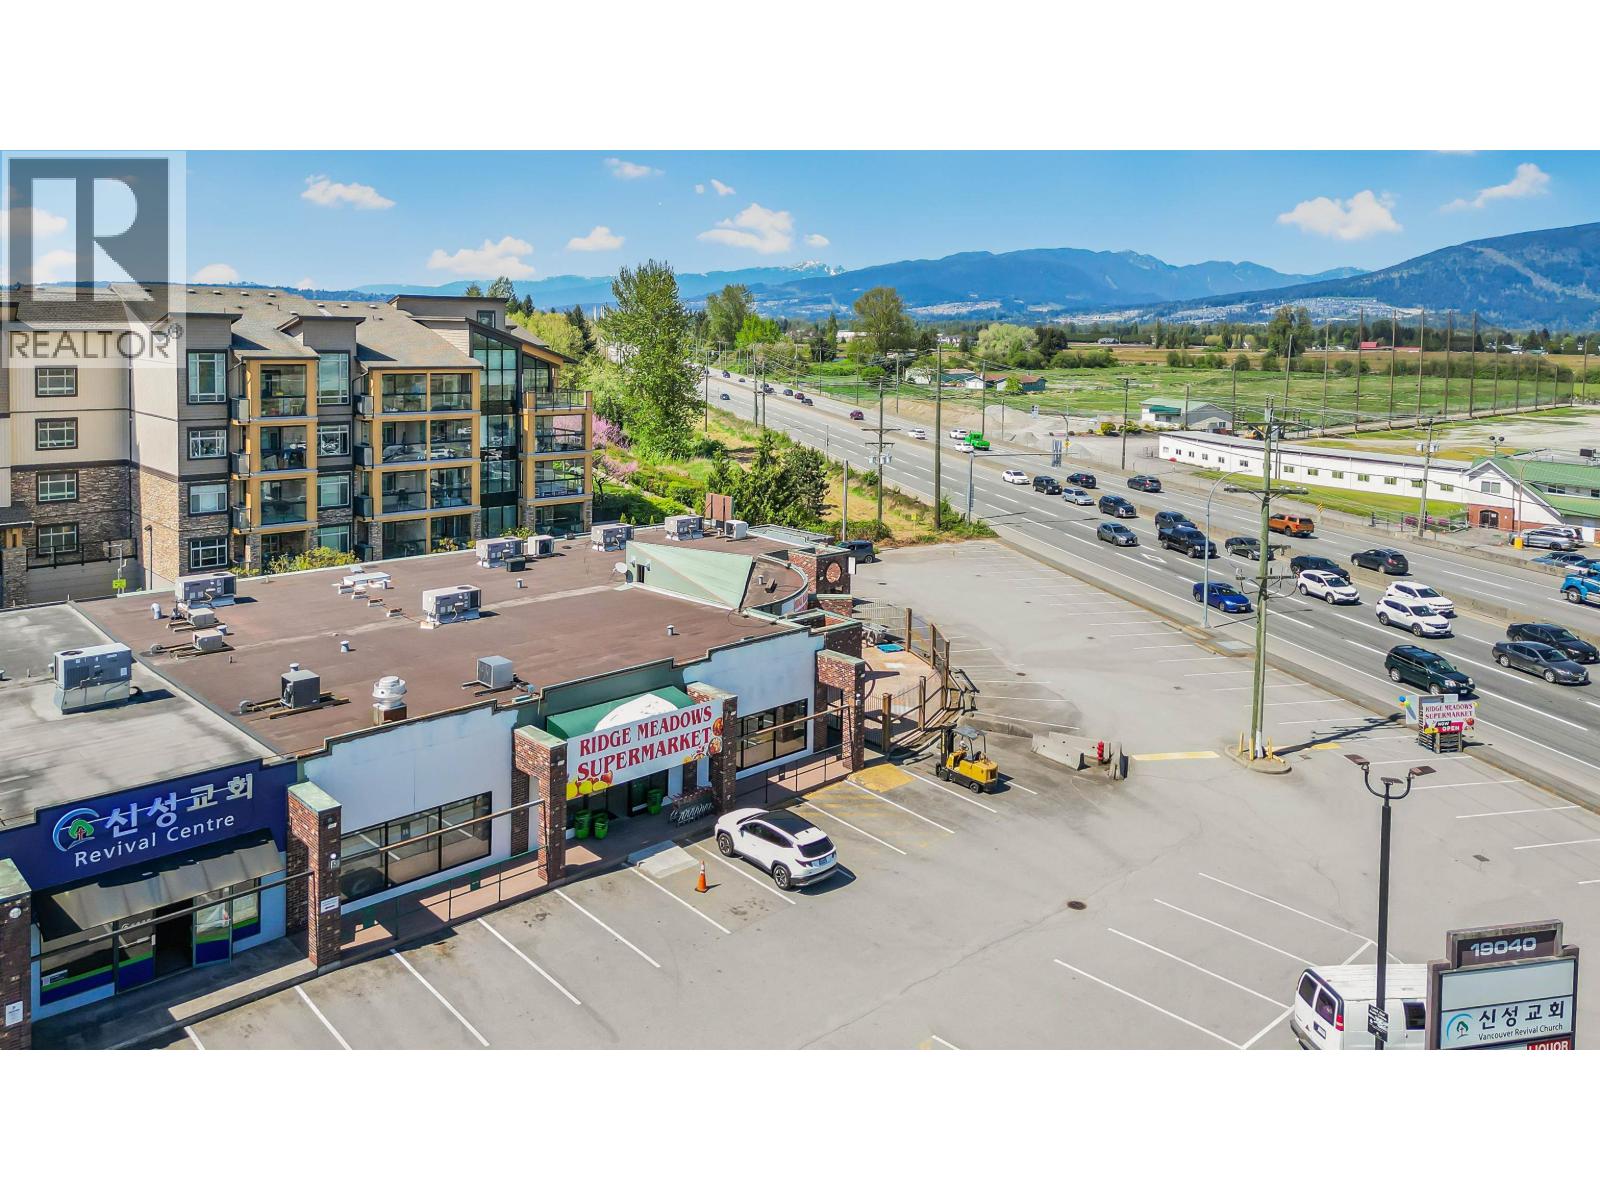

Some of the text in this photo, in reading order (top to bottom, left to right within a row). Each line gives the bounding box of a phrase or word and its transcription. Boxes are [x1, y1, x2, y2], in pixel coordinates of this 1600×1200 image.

[1425, 710, 1472, 719] SUPERMARKET
[1444, 703, 1473, 711] MEADOWS
[579, 705, 713, 757] RIDGE MEADOWS
[577, 727, 712, 781] SUPERMARKET
[104, 773, 253, 838] 신성교회
[74, 814, 235, 868] Revival Centre
[1470, 937, 1537, 957] 19040
[1479, 1000, 1565, 1030] 신성교회
[1478, 1022, 1563, 1041] Vancouver Revival Church
